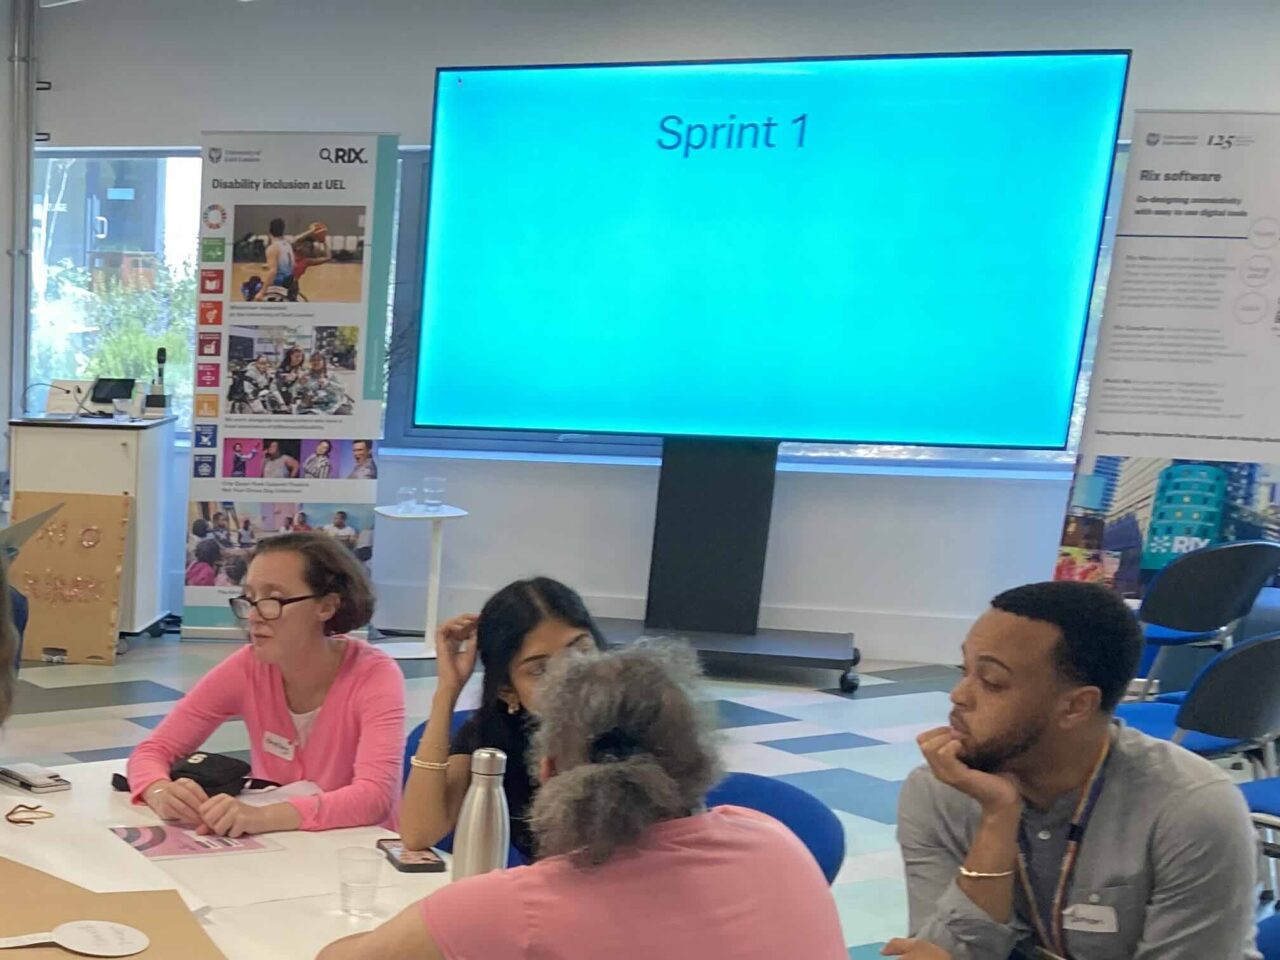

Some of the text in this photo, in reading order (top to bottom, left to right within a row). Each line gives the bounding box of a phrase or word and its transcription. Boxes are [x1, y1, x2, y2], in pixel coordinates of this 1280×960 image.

[656, 112, 809, 159] Sprint 1
[1140, 169, 1223, 182] Rix software
[211, 178, 346, 191] Disability inclusion at UEL
